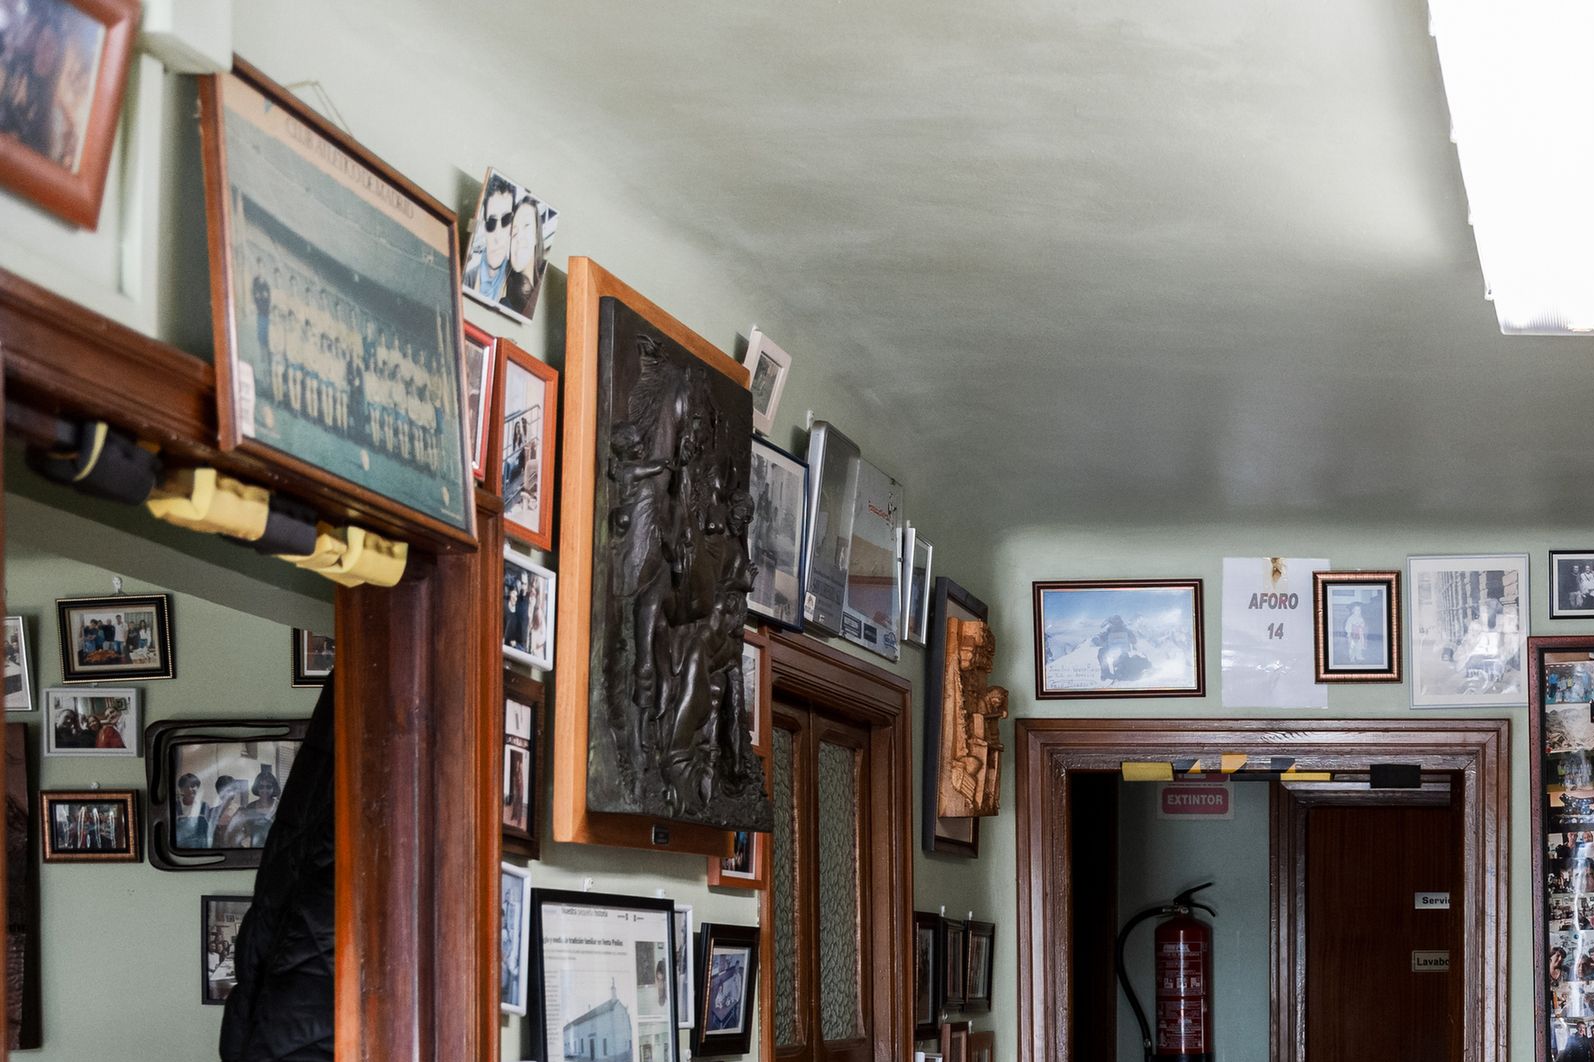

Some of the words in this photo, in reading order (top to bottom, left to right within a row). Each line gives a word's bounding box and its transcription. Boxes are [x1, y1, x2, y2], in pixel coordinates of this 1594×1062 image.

[1248, 593, 1299, 610] AFORO
[1267, 623, 1284, 640] 14
[1167, 794, 1223, 806] EXTINTOR
